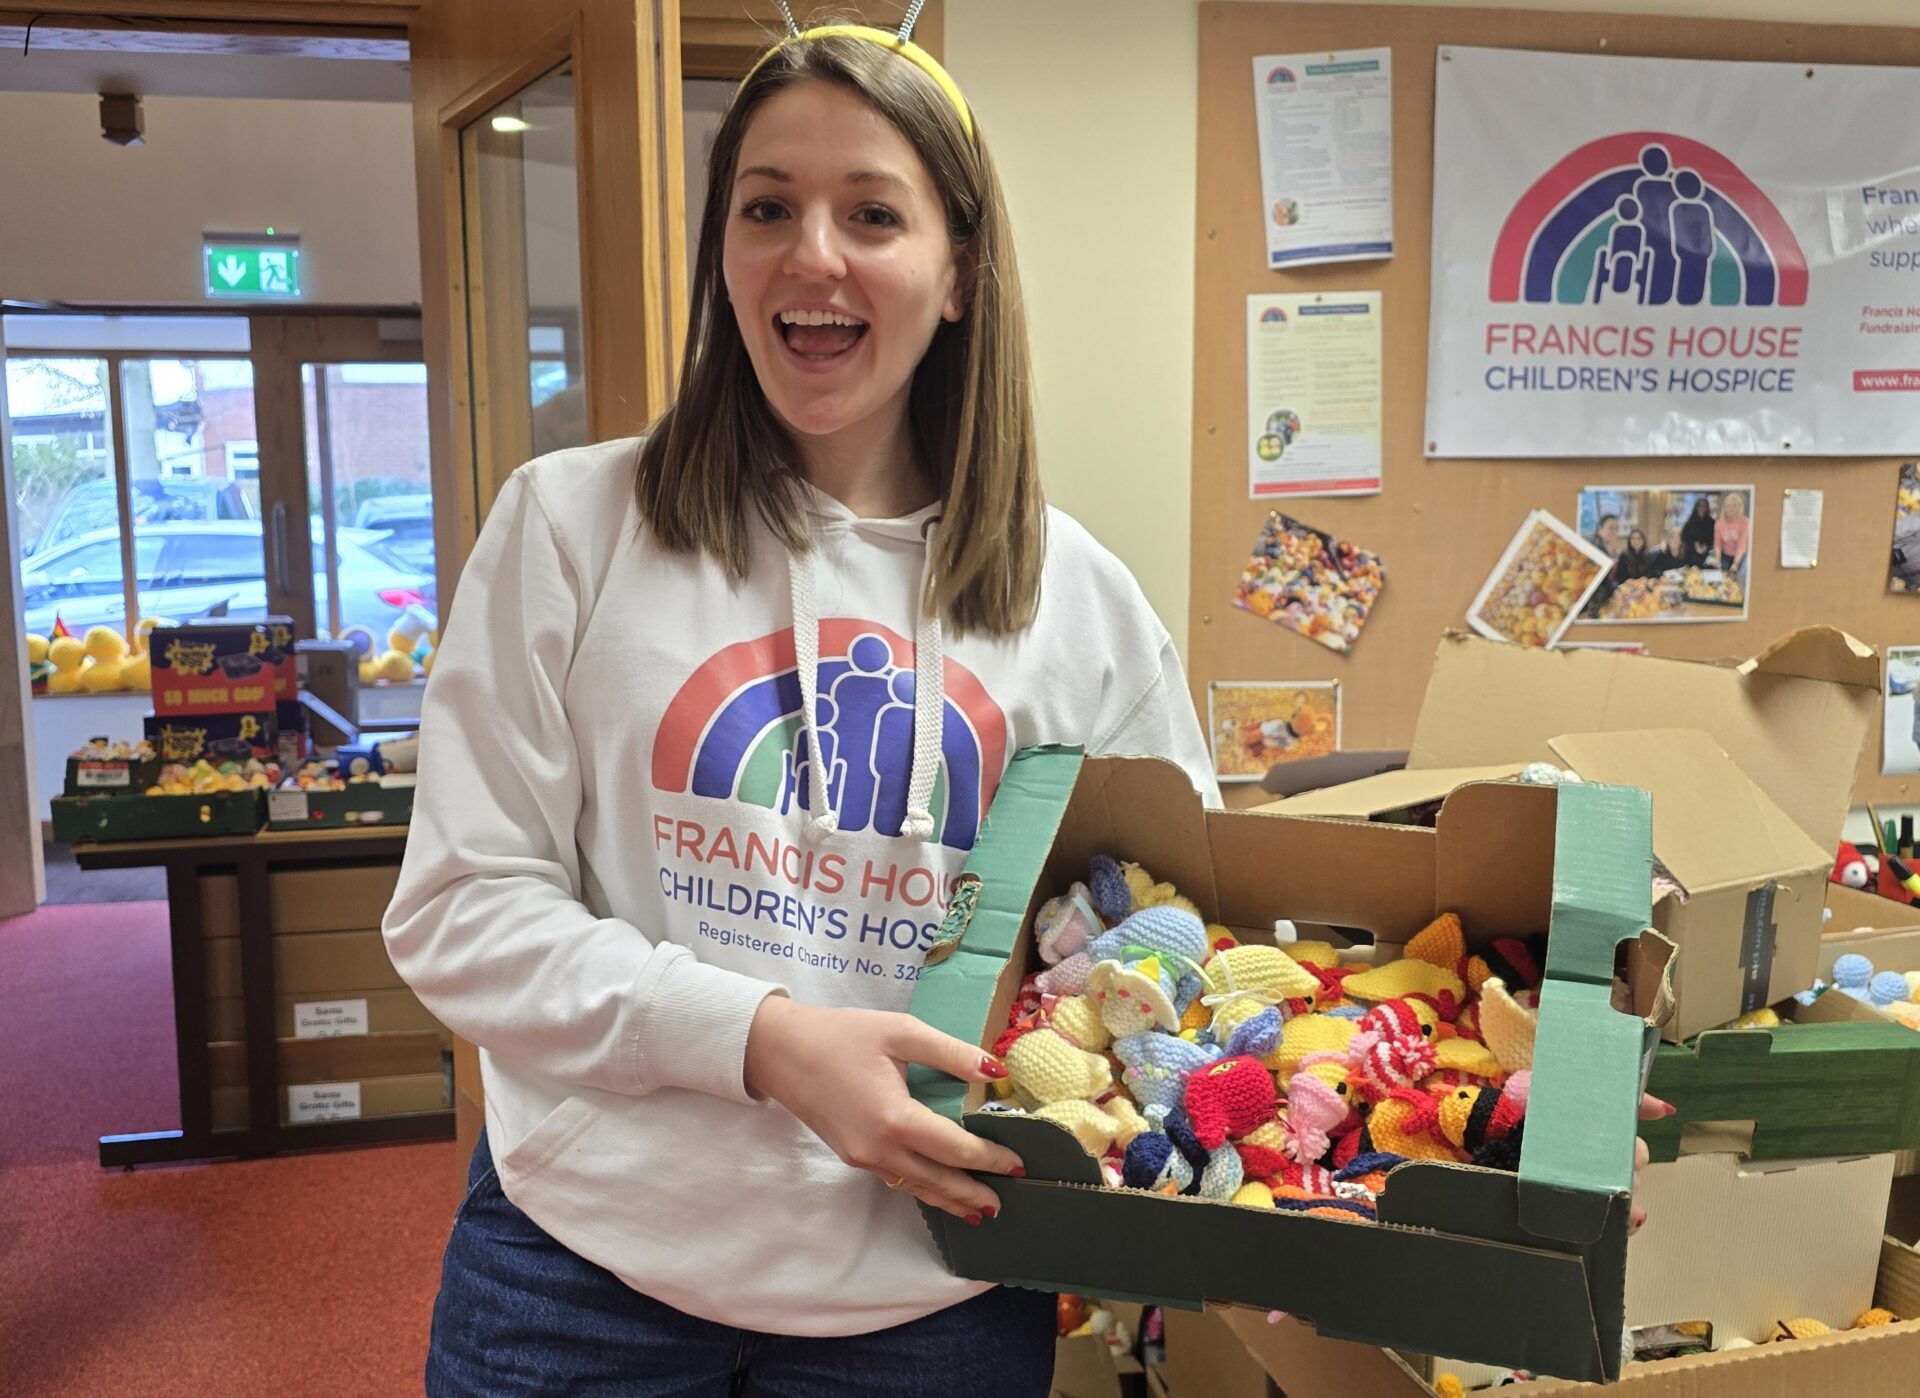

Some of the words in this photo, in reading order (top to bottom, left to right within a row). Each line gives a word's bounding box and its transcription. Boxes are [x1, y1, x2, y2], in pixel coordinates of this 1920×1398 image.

[1861, 305, 1904, 319] Francis
[1485, 323, 1657, 358] FRANCIS
[1667, 325, 1803, 358] HOUSE
[1484, 365, 1660, 393] CHILDREN'S
[1667, 367, 1797, 394] HOSPICE
[654, 814, 847, 894] FRANCIS
[660, 866, 849, 940] CHILDREN'S
[699, 920, 795, 958] Registered
[798, 946, 850, 974] Charity
[855, 957, 888, 978] No.
